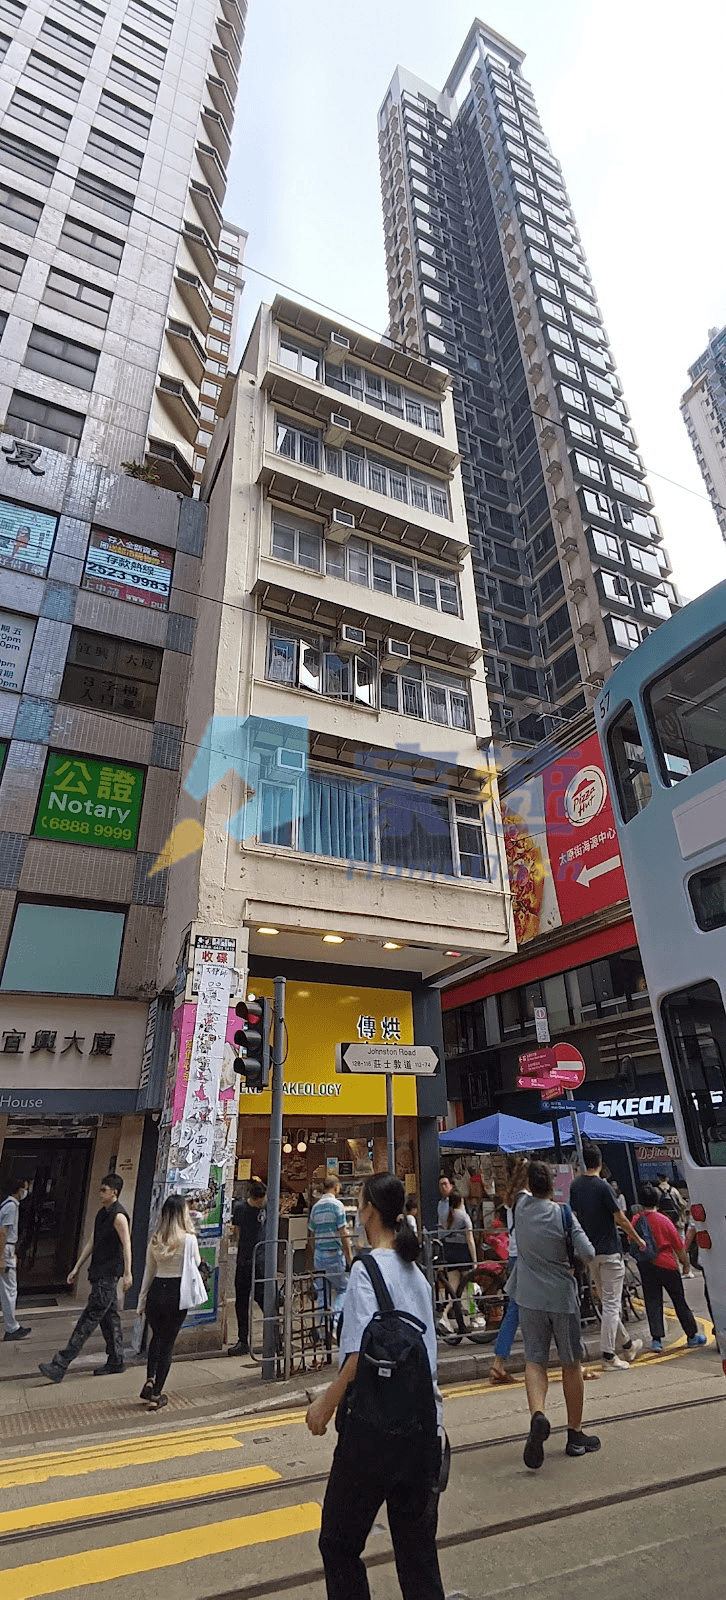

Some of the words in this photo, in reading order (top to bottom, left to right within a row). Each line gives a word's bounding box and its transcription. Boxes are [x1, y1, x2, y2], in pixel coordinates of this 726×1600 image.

[87, 561, 127, 580] 2523
[129, 574, 168, 592] 9983
[600, 691, 610, 718] 57
[53, 761, 136, 803] 公證
[47, 791, 132, 824] Notary
[573, 786, 597, 812] Pizza
[578, 795, 597, 817] Hut
[58, 817, 90, 835] 6888
[94, 824, 132, 841] 9999
[558, 827, 617, 867] 太原街海源中心
[202, 949, 229, 964] 收碟
[356, 1014, 401, 1040] 傳烘
[0, 1028, 116, 1057] 宜興大廈
[367, 1047, 398, 1056] Johnston
[399, 1048, 417, 1056] Road
[373, 1059, 412, 1070] 莊士敦道
[0, 1095, 43, 1108] House
[668, 1146, 681, 1158] 4.0
